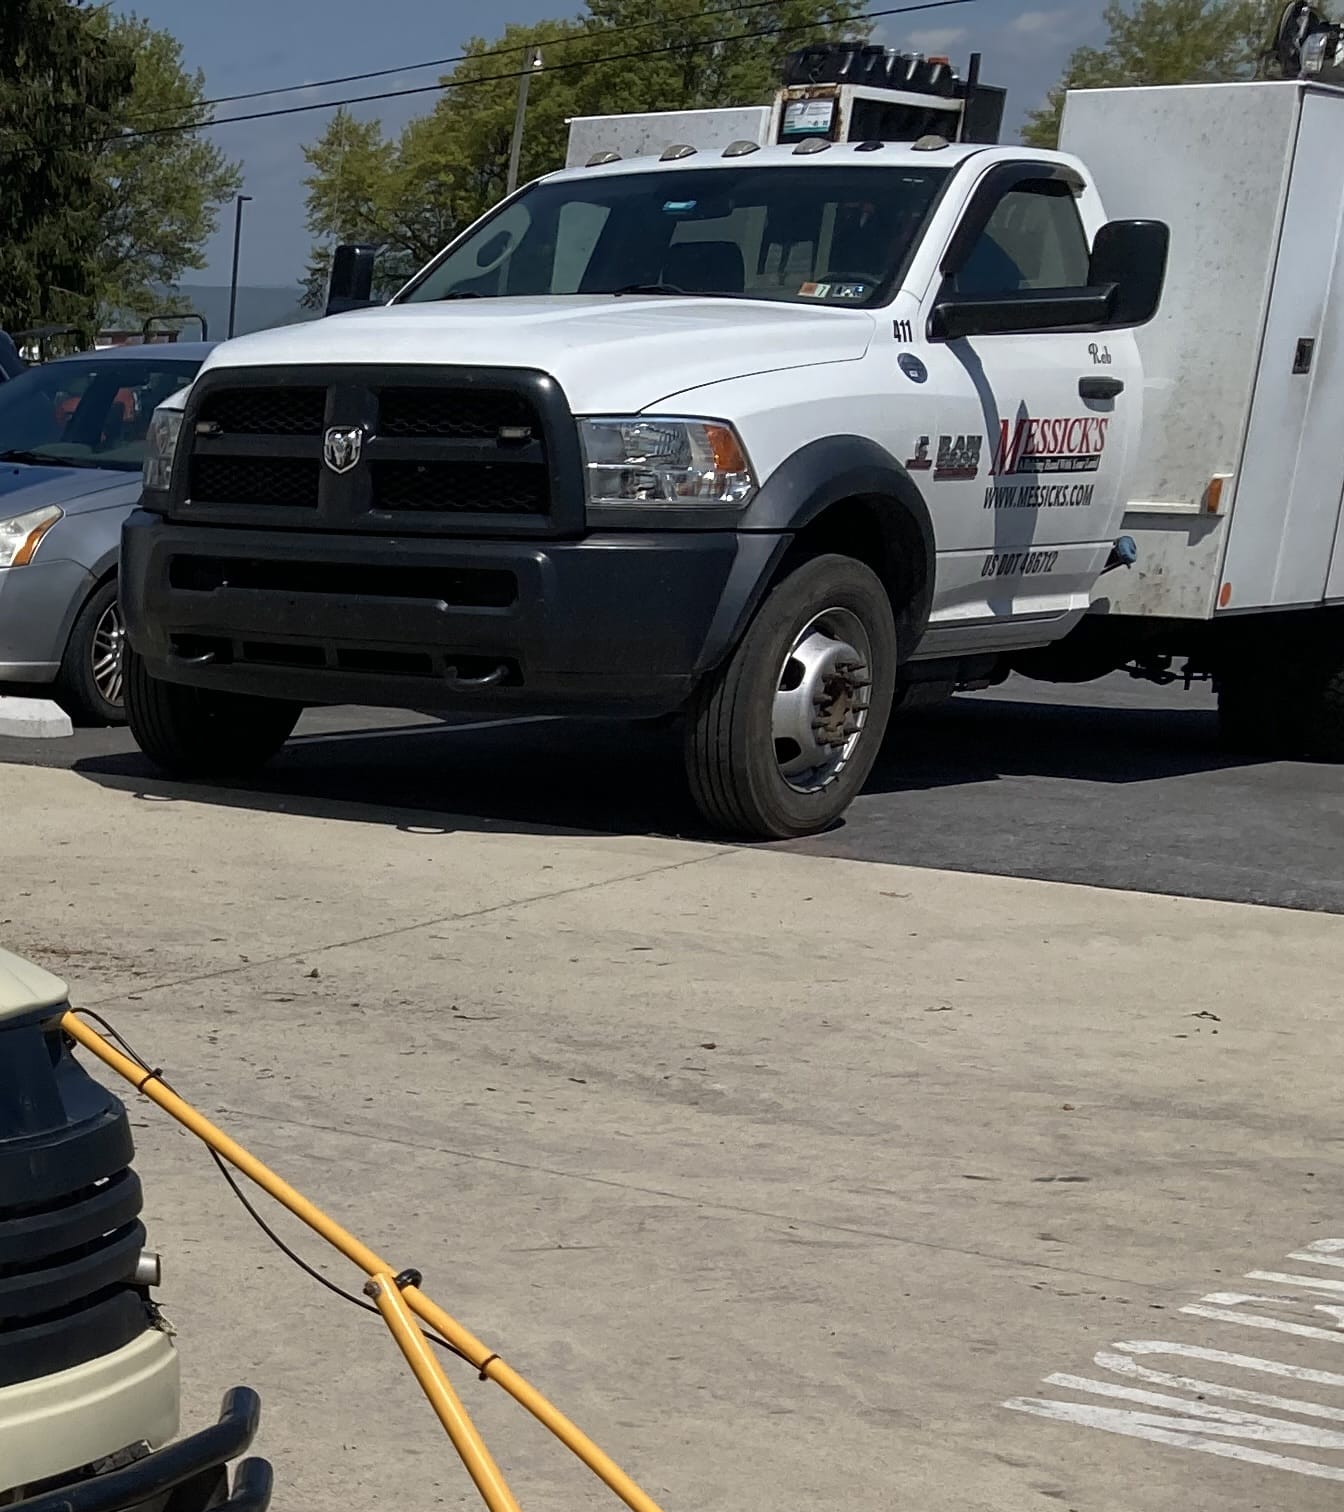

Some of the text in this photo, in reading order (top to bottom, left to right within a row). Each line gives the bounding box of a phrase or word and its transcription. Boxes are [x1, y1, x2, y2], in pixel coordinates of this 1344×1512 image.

[892, 320, 913, 343] 411
[987, 417, 1109, 476] MESSICK'S
[983, 484, 1095, 509] WWW.MESSICKS.COM
[981, 554, 999, 577] US
[996, 552, 1023, 576] DOT
